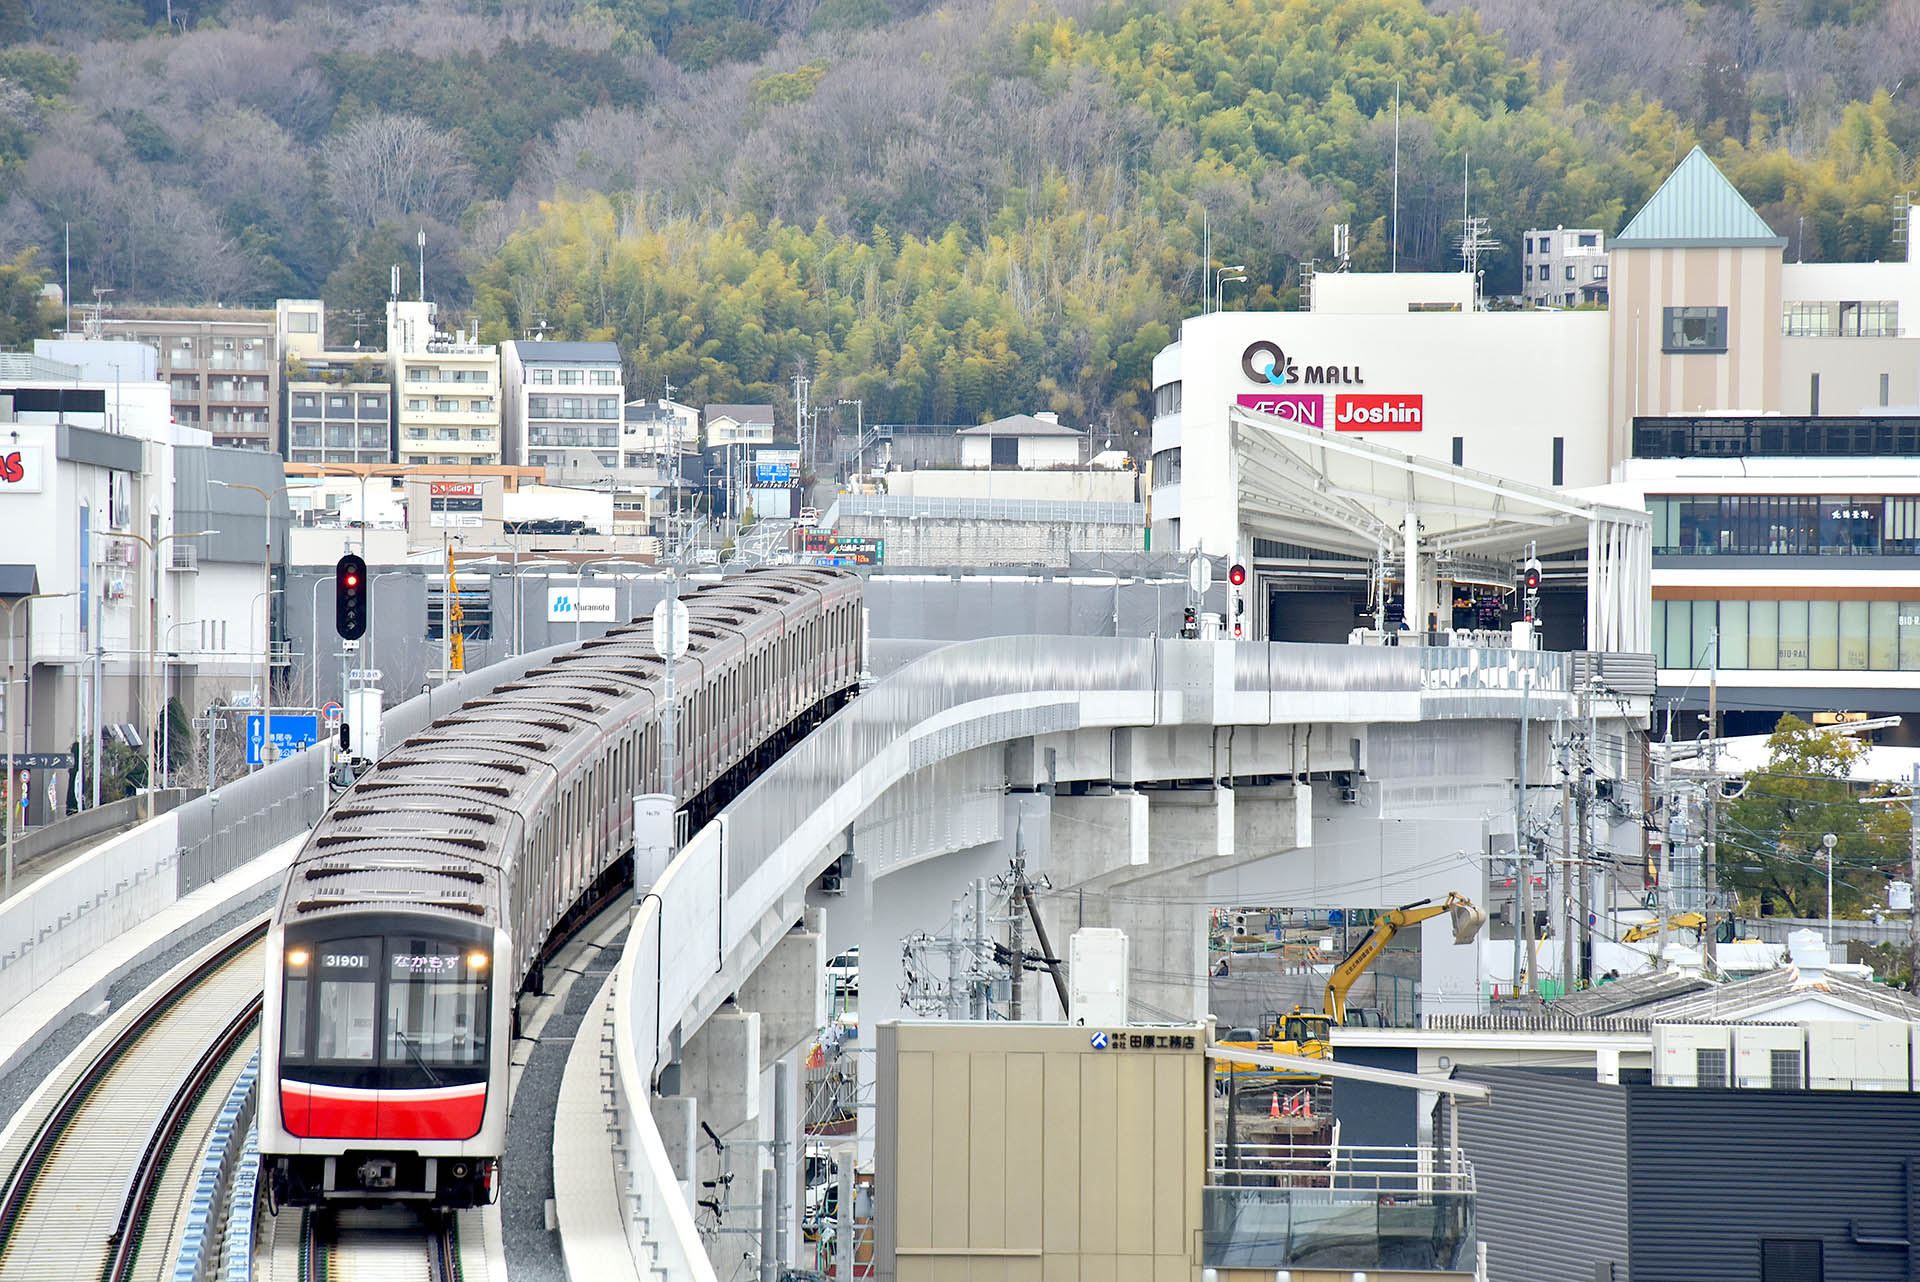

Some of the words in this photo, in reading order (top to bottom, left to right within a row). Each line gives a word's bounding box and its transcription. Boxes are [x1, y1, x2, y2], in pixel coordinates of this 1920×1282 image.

[1241, 340, 1299, 385] Q's
[1304, 366, 1364, 384] MALL
[1337, 402, 1421, 423] Joshin
[573, 602, 610, 611] Muramoto
[326, 955, 363, 967] 31901
[394, 955, 460, 968] なかもず
[1129, 1034, 1195, 1049] 田原工務店
